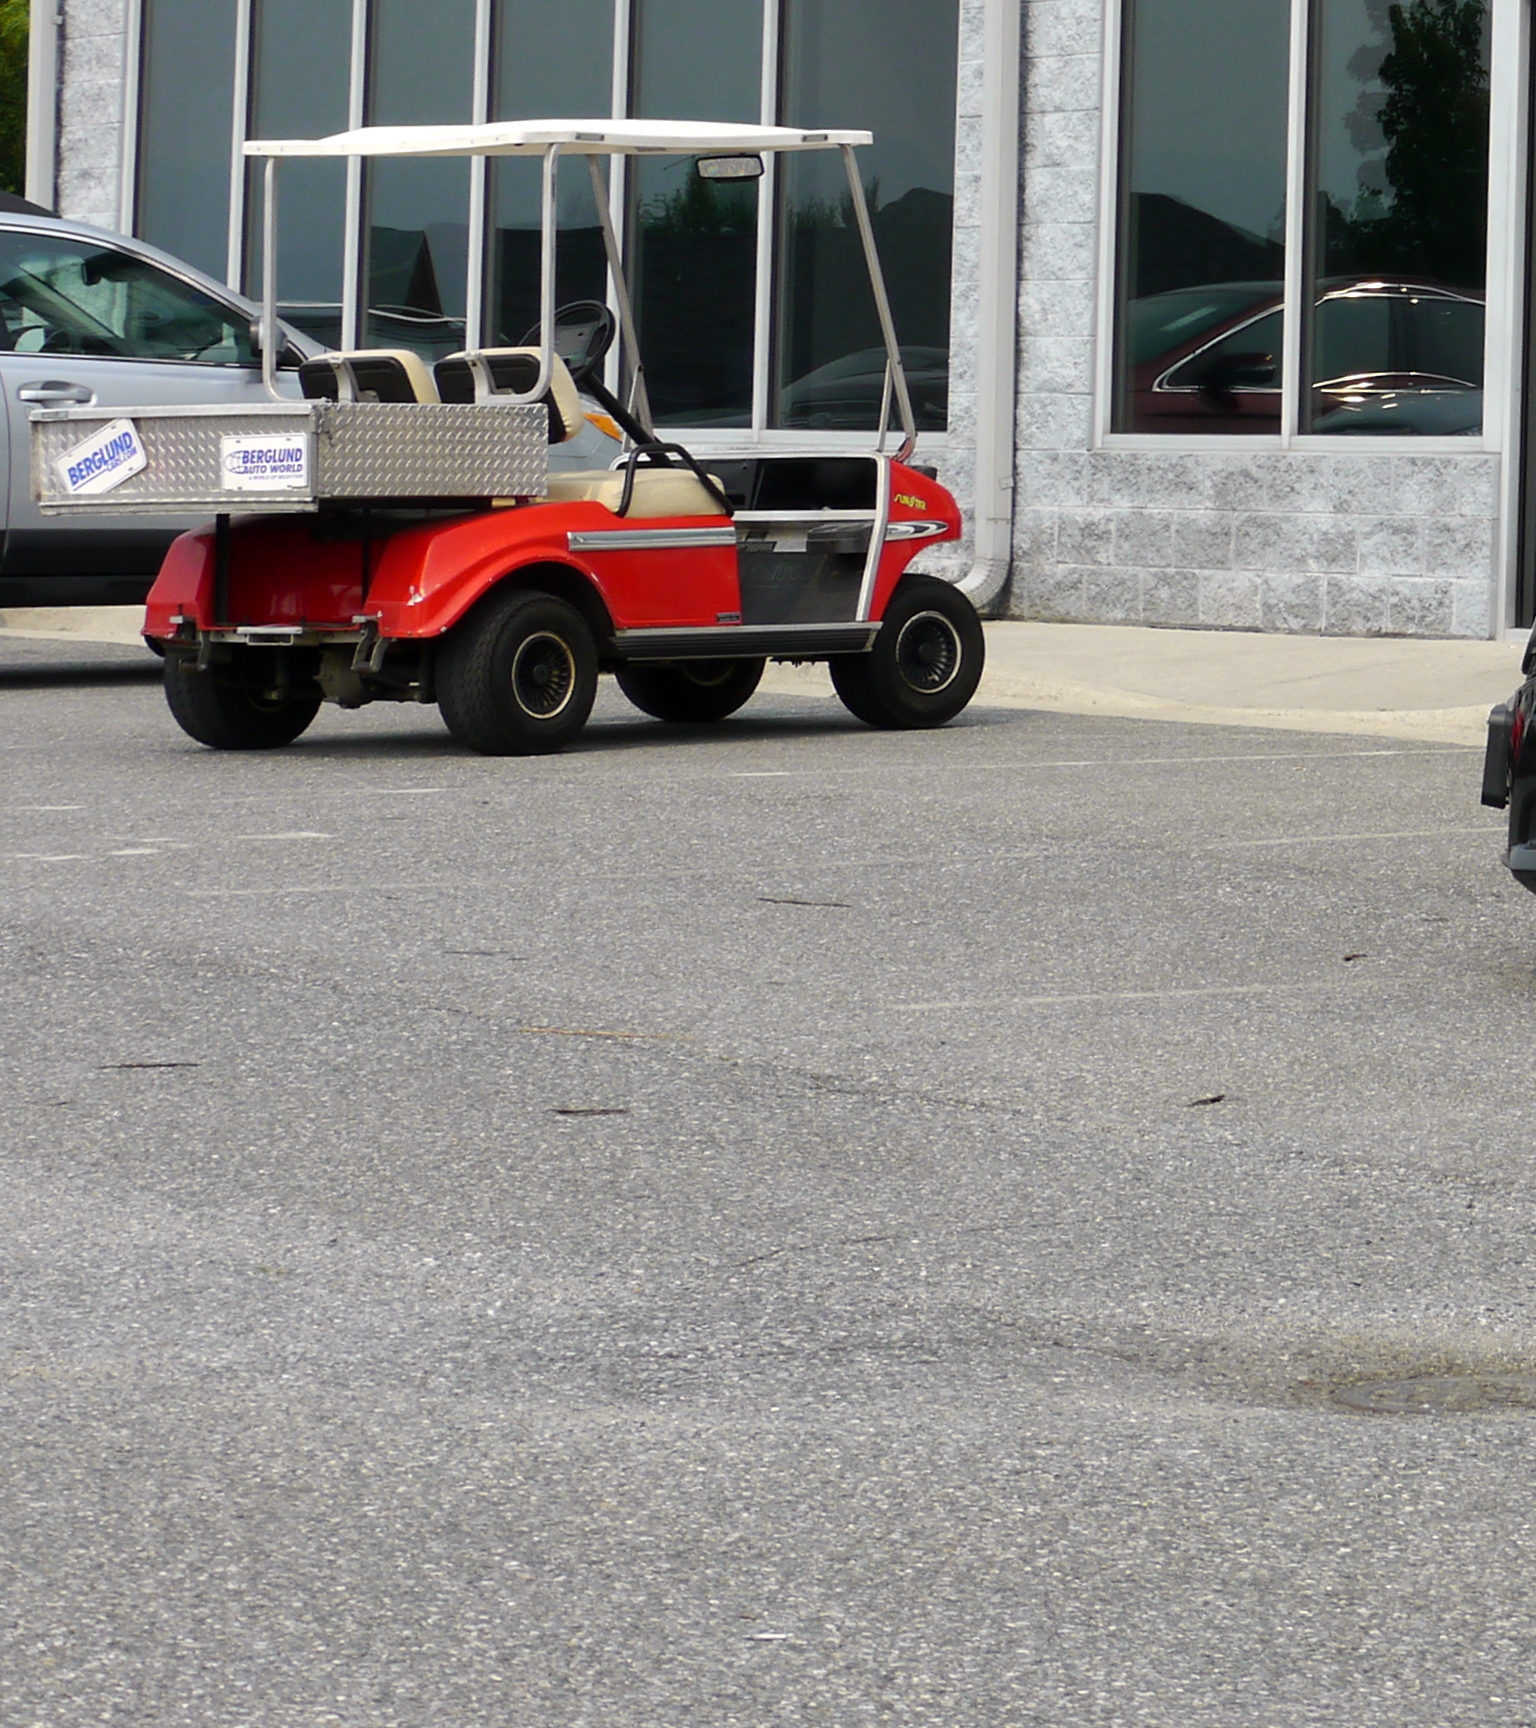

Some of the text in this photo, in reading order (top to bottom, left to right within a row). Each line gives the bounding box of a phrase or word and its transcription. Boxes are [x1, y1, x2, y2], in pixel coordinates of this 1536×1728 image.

[68, 432, 134, 487] BERGLUND
[242, 448, 303, 464] BERGLUND
[243, 464, 303, 475] AUTO WORLD
